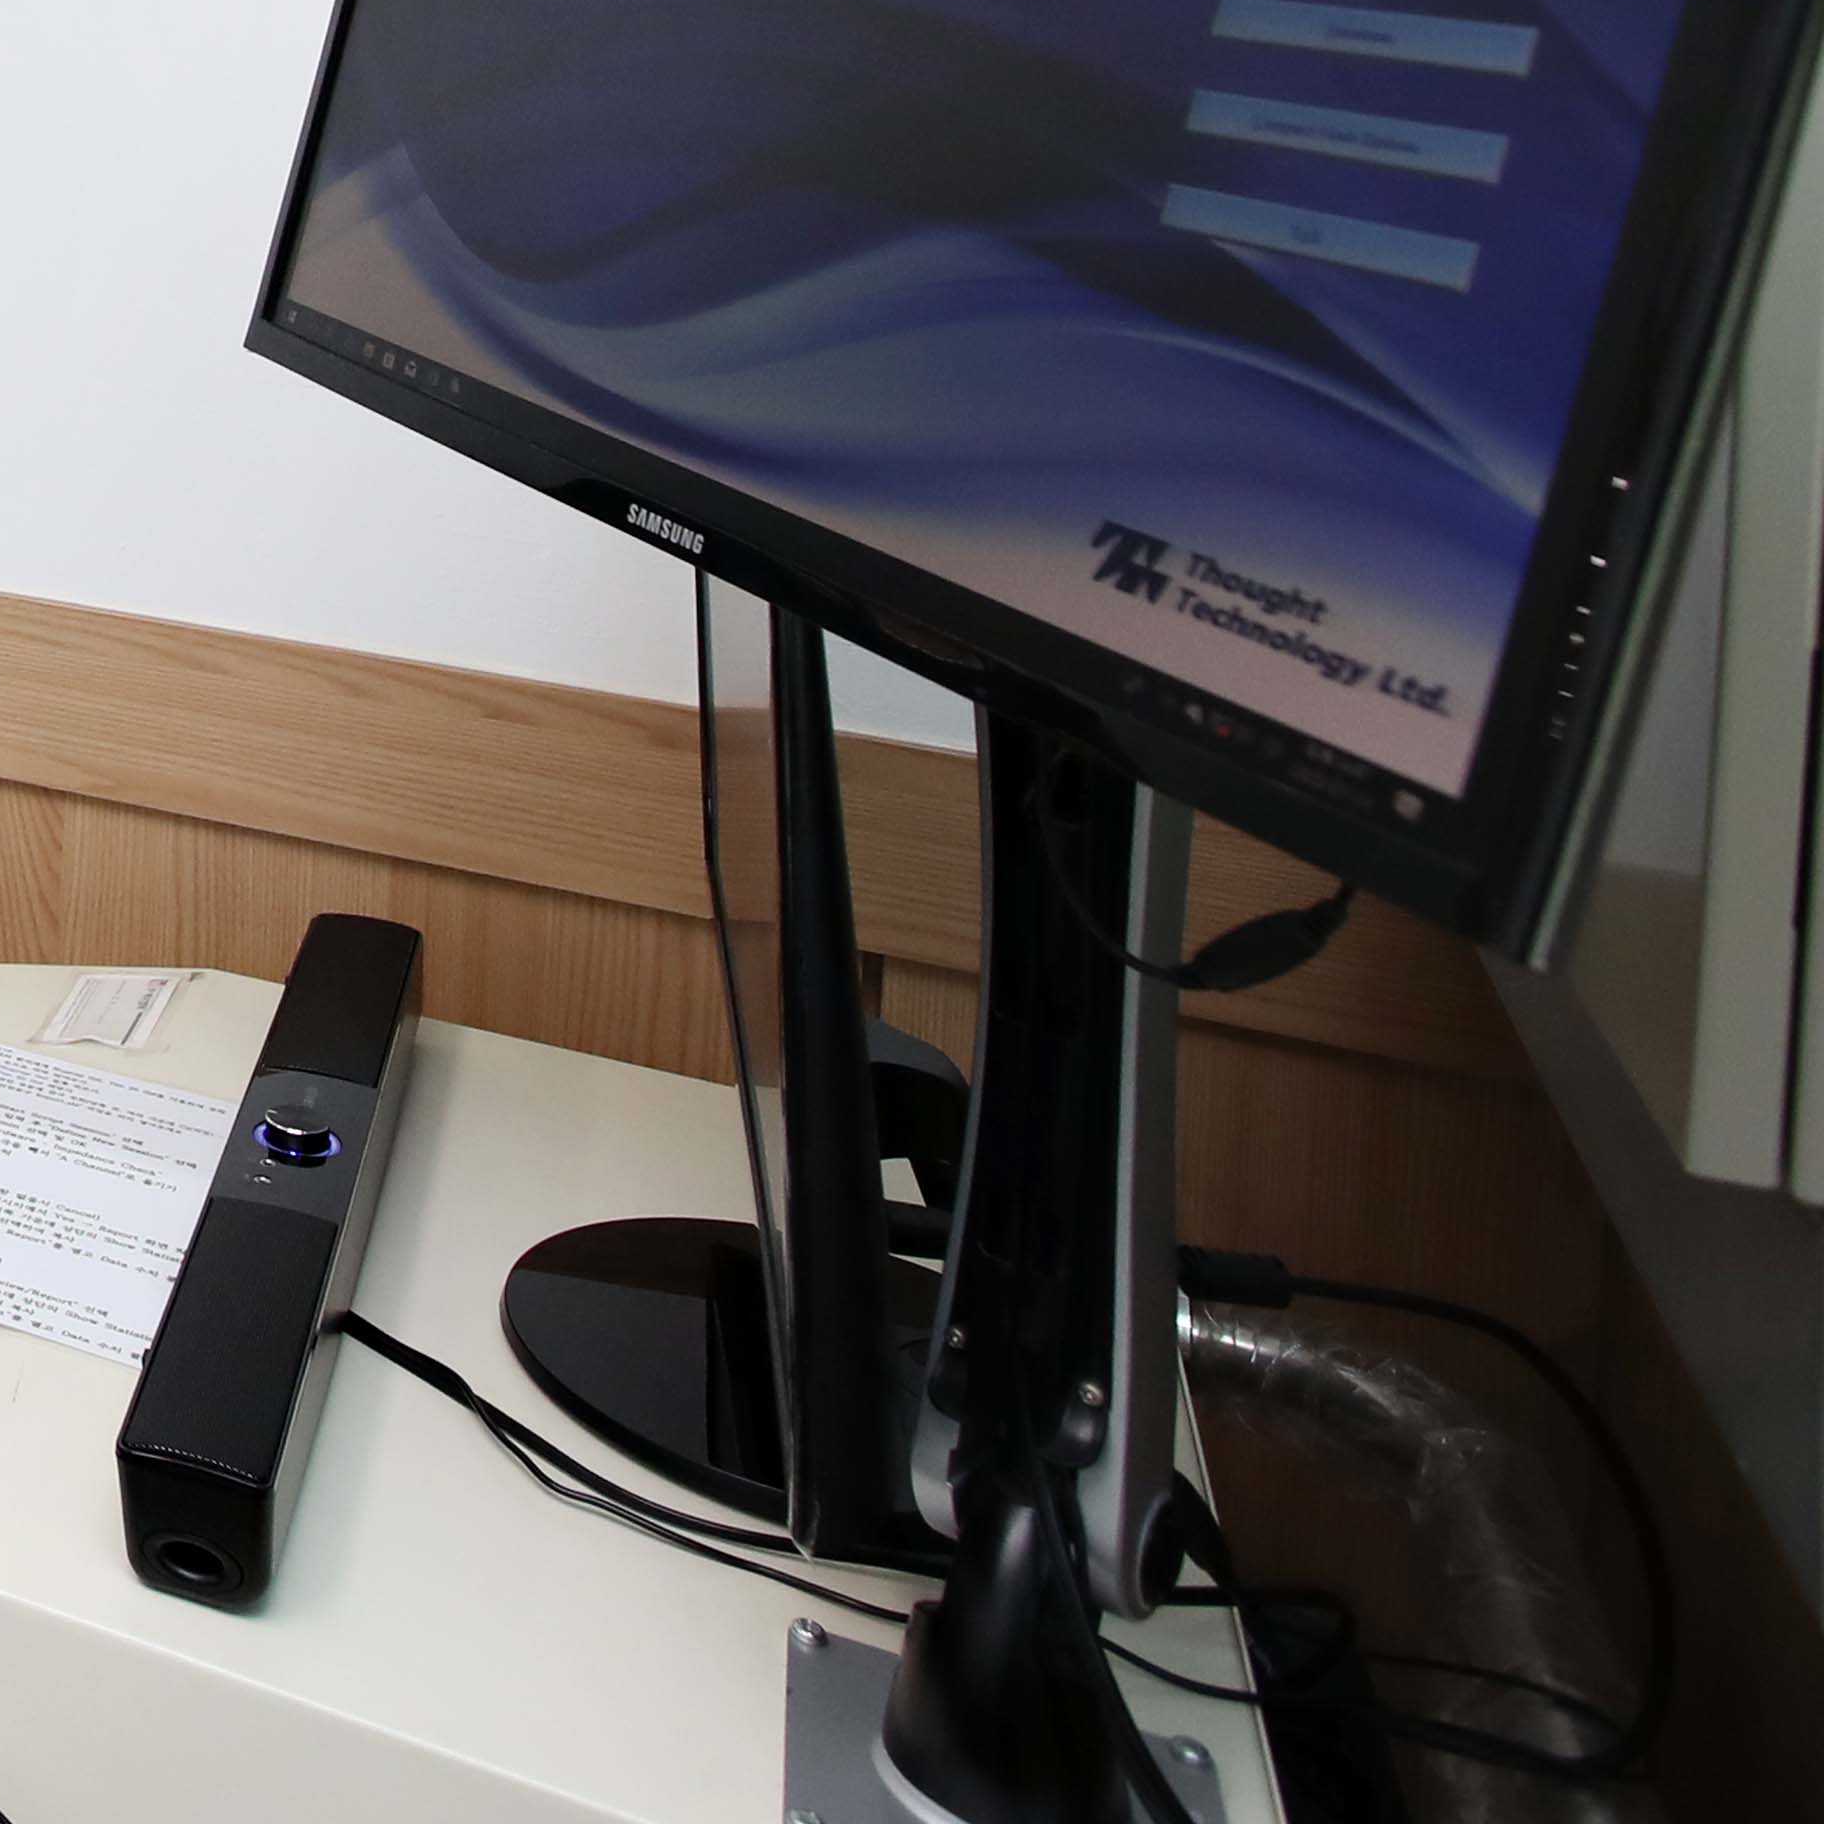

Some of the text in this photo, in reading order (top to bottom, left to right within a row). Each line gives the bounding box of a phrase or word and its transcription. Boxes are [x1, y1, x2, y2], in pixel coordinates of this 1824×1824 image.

[627, 503, 704, 554] SAMSUNG
[1187, 552, 1328, 623] Thought
[1176, 586, 1451, 717] Technology Ltd.
